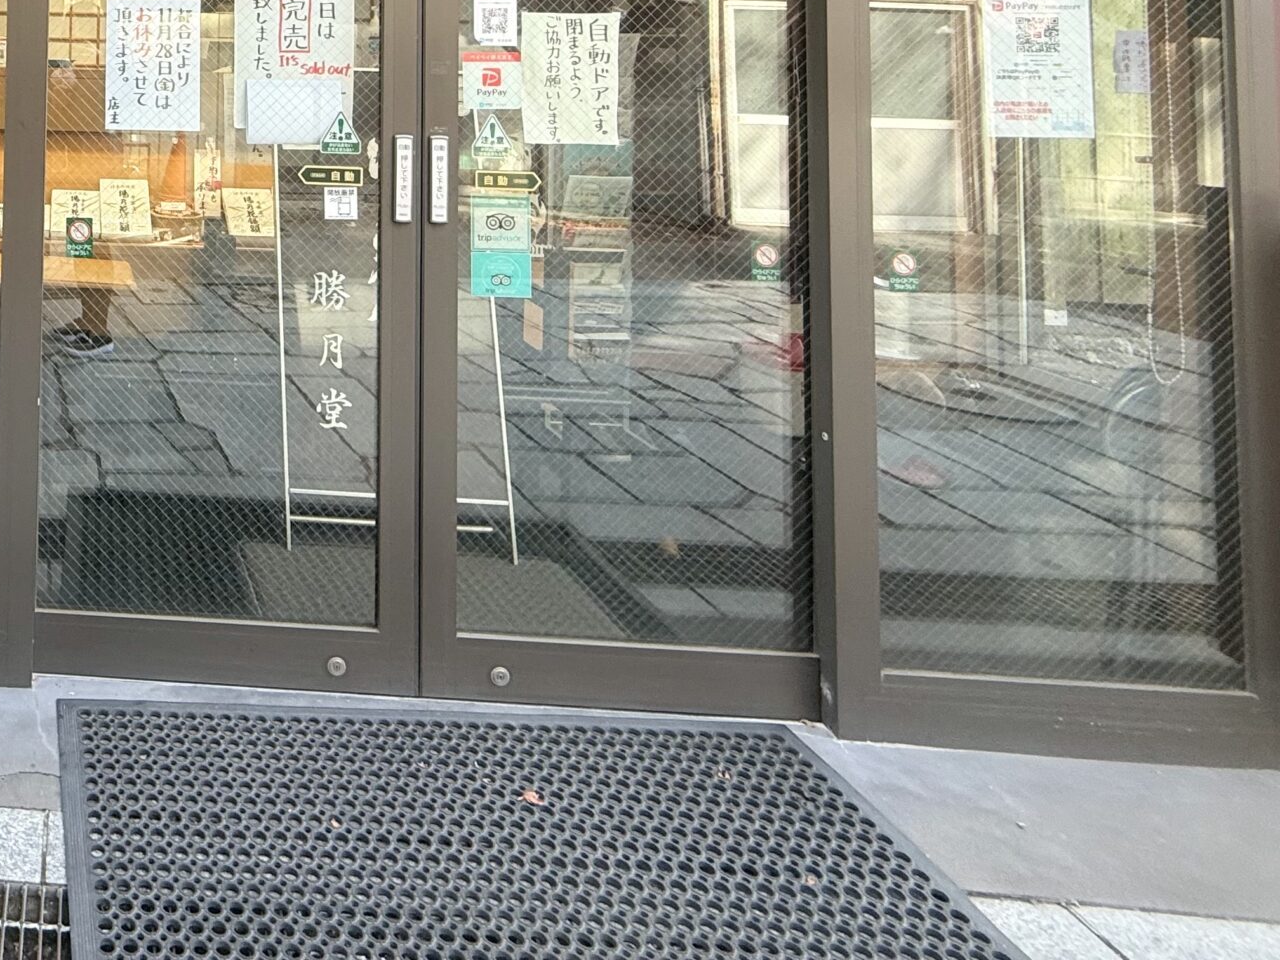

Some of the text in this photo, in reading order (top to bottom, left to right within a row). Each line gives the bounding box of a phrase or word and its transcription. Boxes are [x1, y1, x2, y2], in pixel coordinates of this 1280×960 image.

[1005, 1, 1039, 11] PayPay
[132, 7, 153, 107] お休みさせて
[544, 15, 562, 143] ご協力お願いします。
[587, 18, 611, 135] 自動ドアです。
[476, 88, 508, 97] PayPay
[107, 96, 120, 124] 店主
[329, 131, 353, 141] 注意
[481, 136, 504, 145] 注意
[331, 170, 355, 182] 自動
[483, 175, 508, 186] 自動
[477, 234, 521, 242] tripadvisor
[310, 269, 353, 430] 勝月堂
